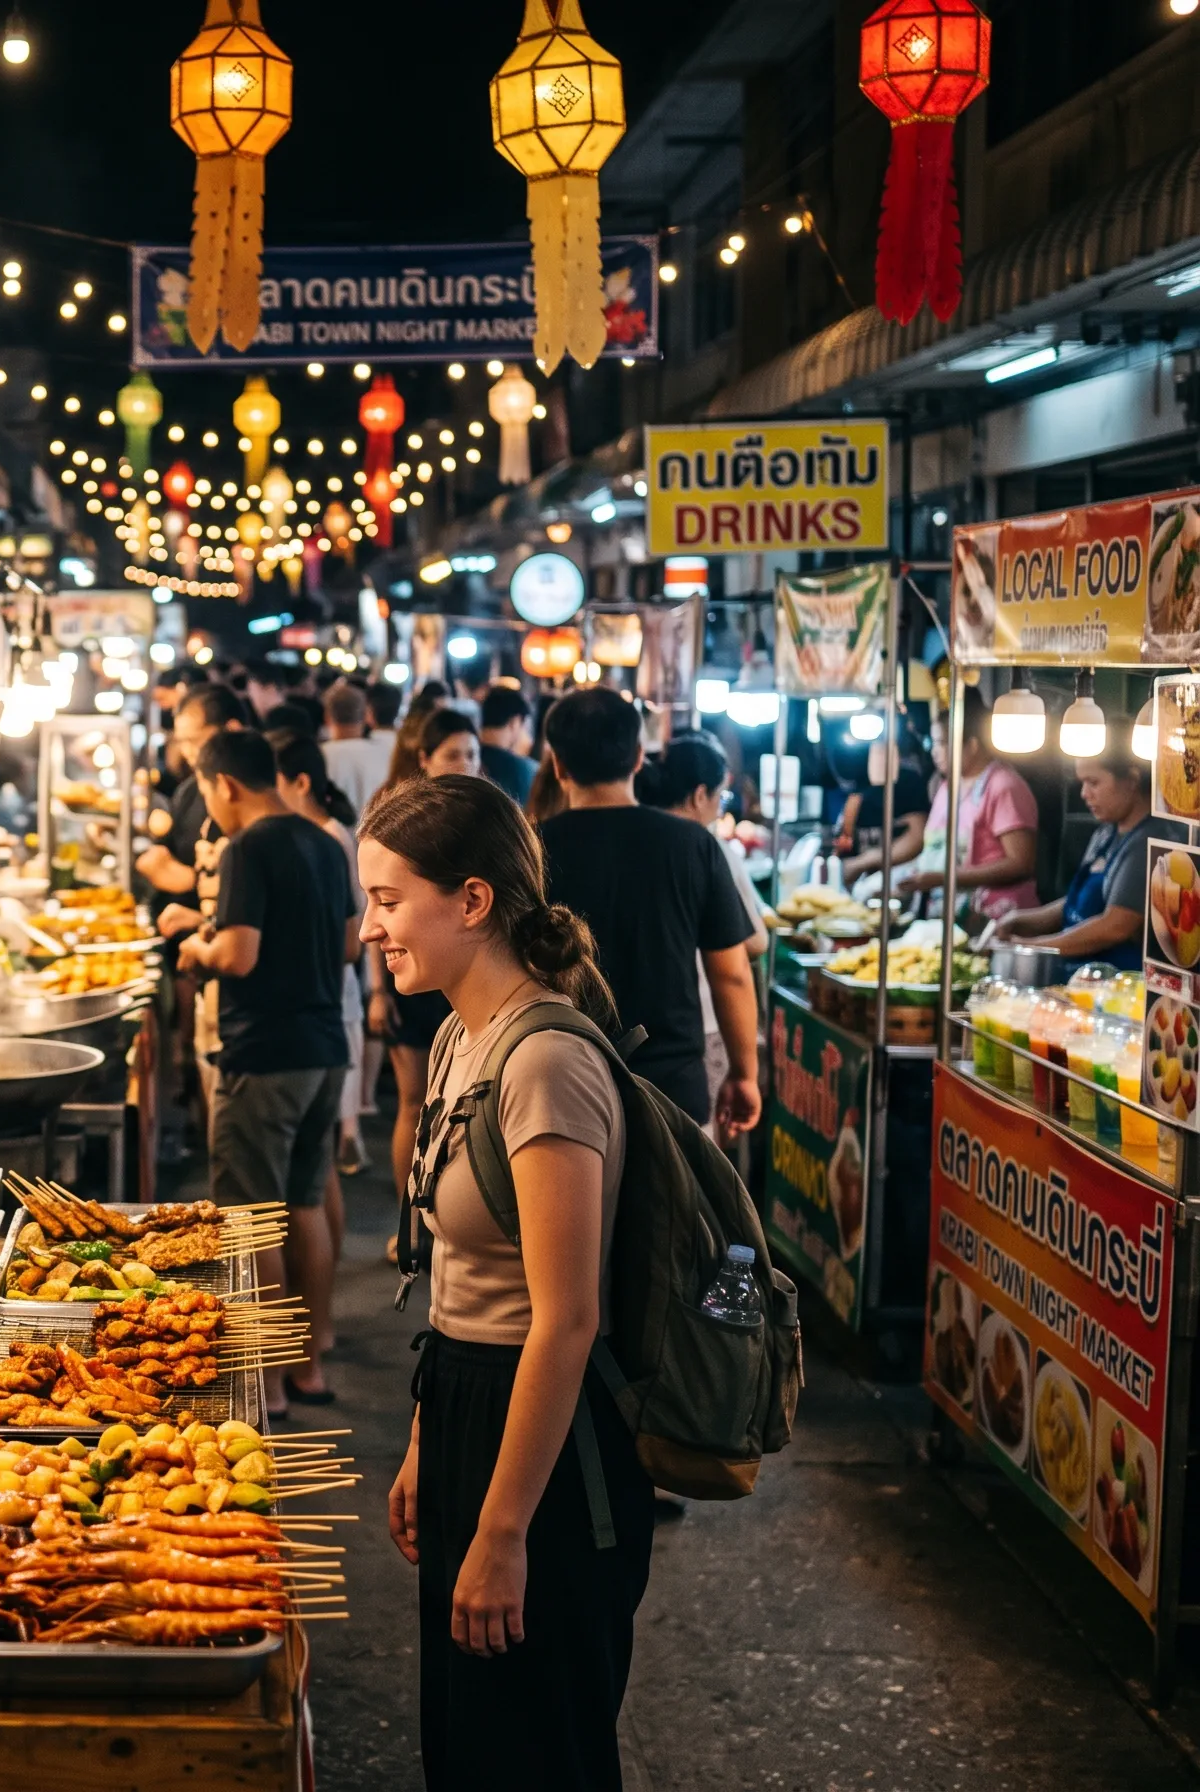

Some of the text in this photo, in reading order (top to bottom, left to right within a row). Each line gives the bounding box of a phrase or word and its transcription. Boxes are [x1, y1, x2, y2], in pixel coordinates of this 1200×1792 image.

[252, 316, 536, 345] ABI TOWN NIGHT MARKE
[675, 501, 862, 545] DRINKS
[1001, 540, 1141, 603] LOCAL FOOD
[983, 1241, 1027, 1303] TOWN
[1029, 1272, 1079, 1345] NIGHT
[1081, 1314, 1154, 1410] MARKET
